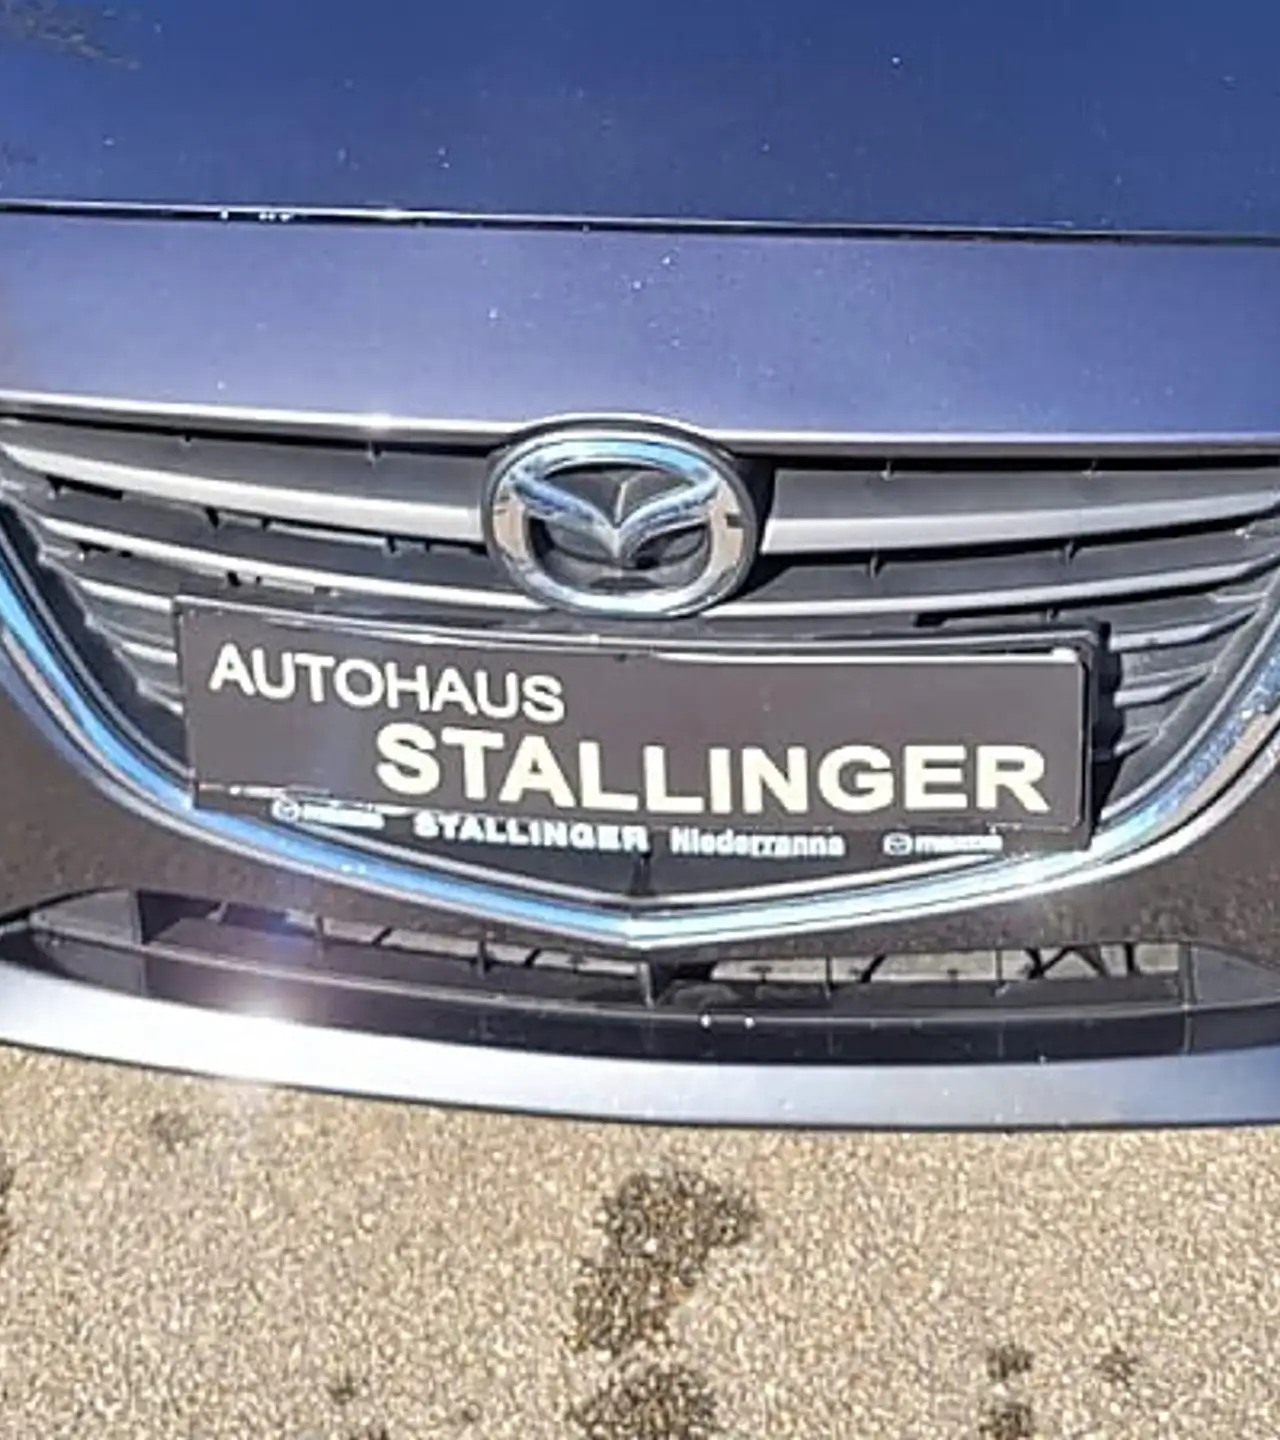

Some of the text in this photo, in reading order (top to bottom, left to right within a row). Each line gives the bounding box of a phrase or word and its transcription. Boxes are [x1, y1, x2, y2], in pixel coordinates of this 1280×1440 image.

[209, 642, 565, 724] AUTOHAUS
[376, 722, 1050, 814] STALLINGER
[414, 810, 649, 852] STALLINGER
